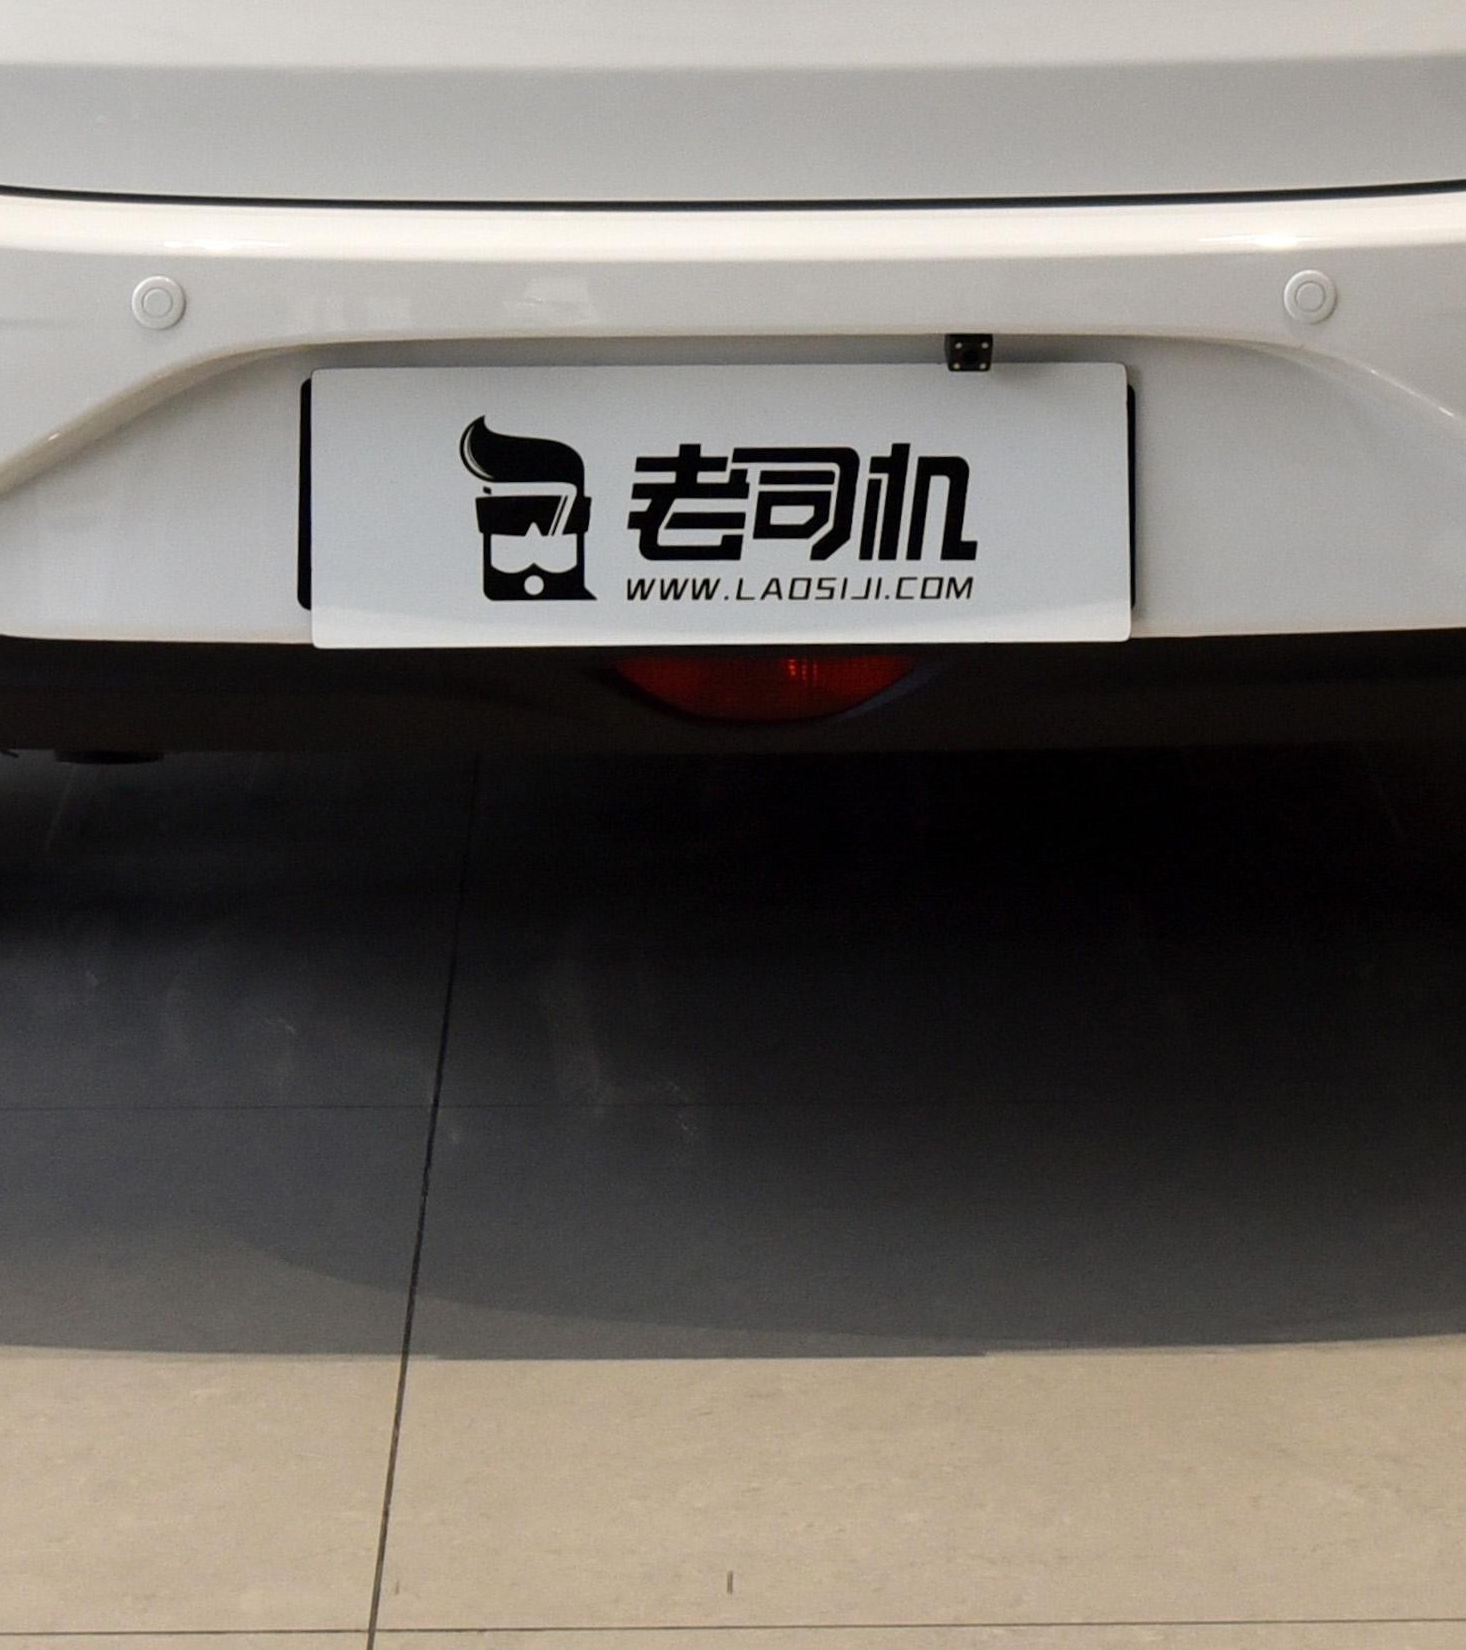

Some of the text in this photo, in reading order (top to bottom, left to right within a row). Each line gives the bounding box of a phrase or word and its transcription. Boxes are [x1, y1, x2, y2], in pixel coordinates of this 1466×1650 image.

[626, 442, 979, 562] 老司机
[625, 574, 975, 602] WWW.LAOSIJI.COM
